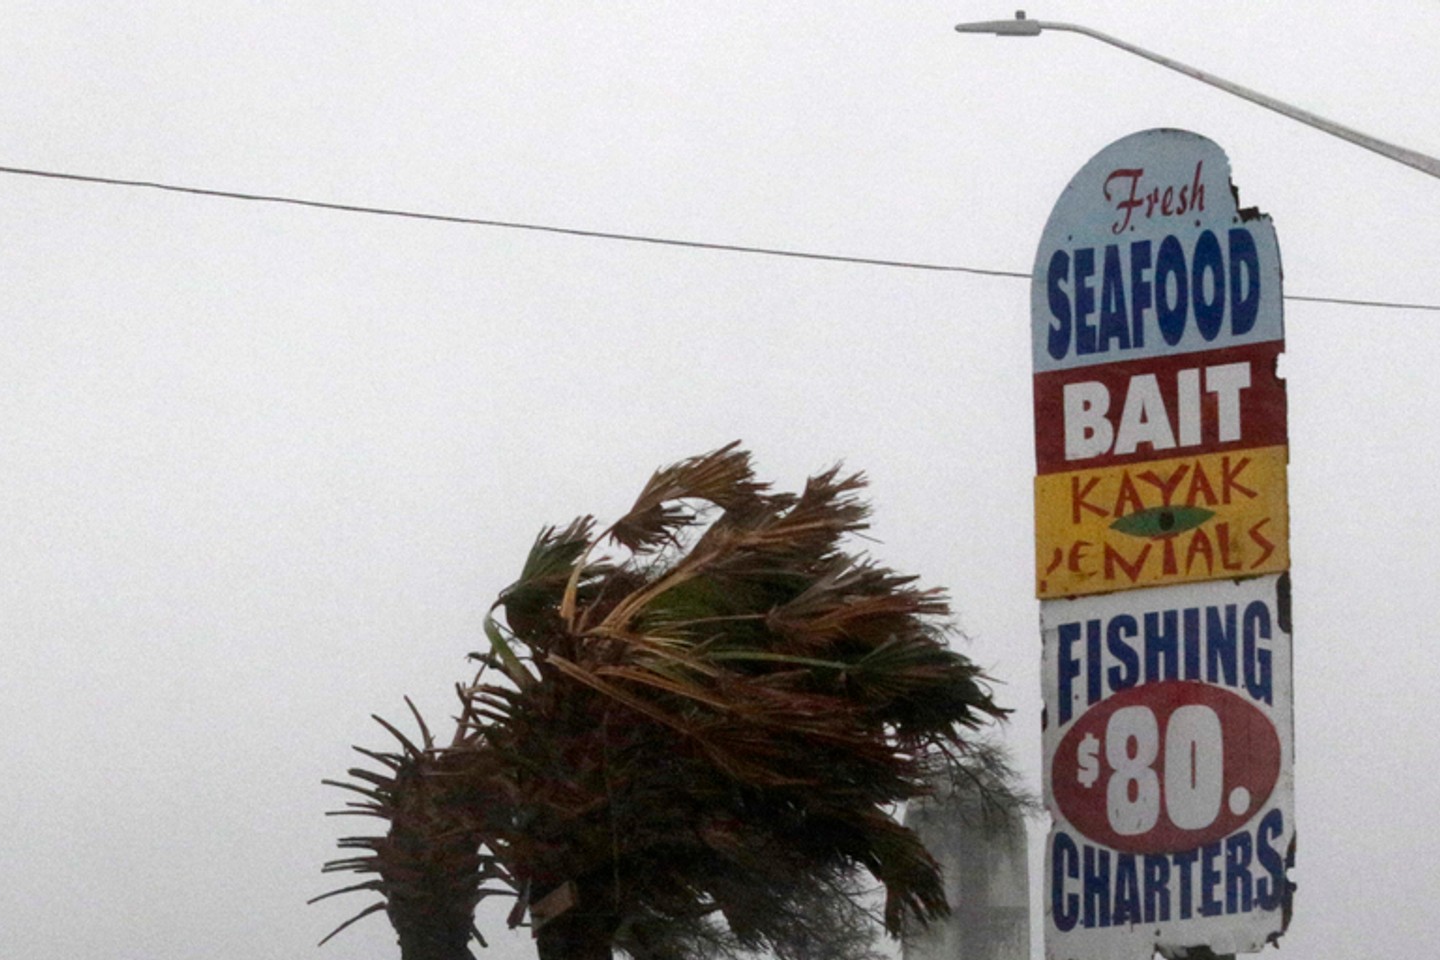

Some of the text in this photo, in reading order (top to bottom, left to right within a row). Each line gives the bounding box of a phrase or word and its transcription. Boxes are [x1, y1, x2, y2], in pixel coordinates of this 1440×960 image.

[1103, 160, 1206, 234] Fresh
[1046, 227, 1261, 360] SEAFOOD
[1062, 361, 1252, 461] BAIT
[1071, 455, 1259, 524] KAYAK
[1058, 600, 1273, 728] FISHING
[1076, 704, 1251, 836] $80.
[1051, 807, 1285, 932] CHARTERS
